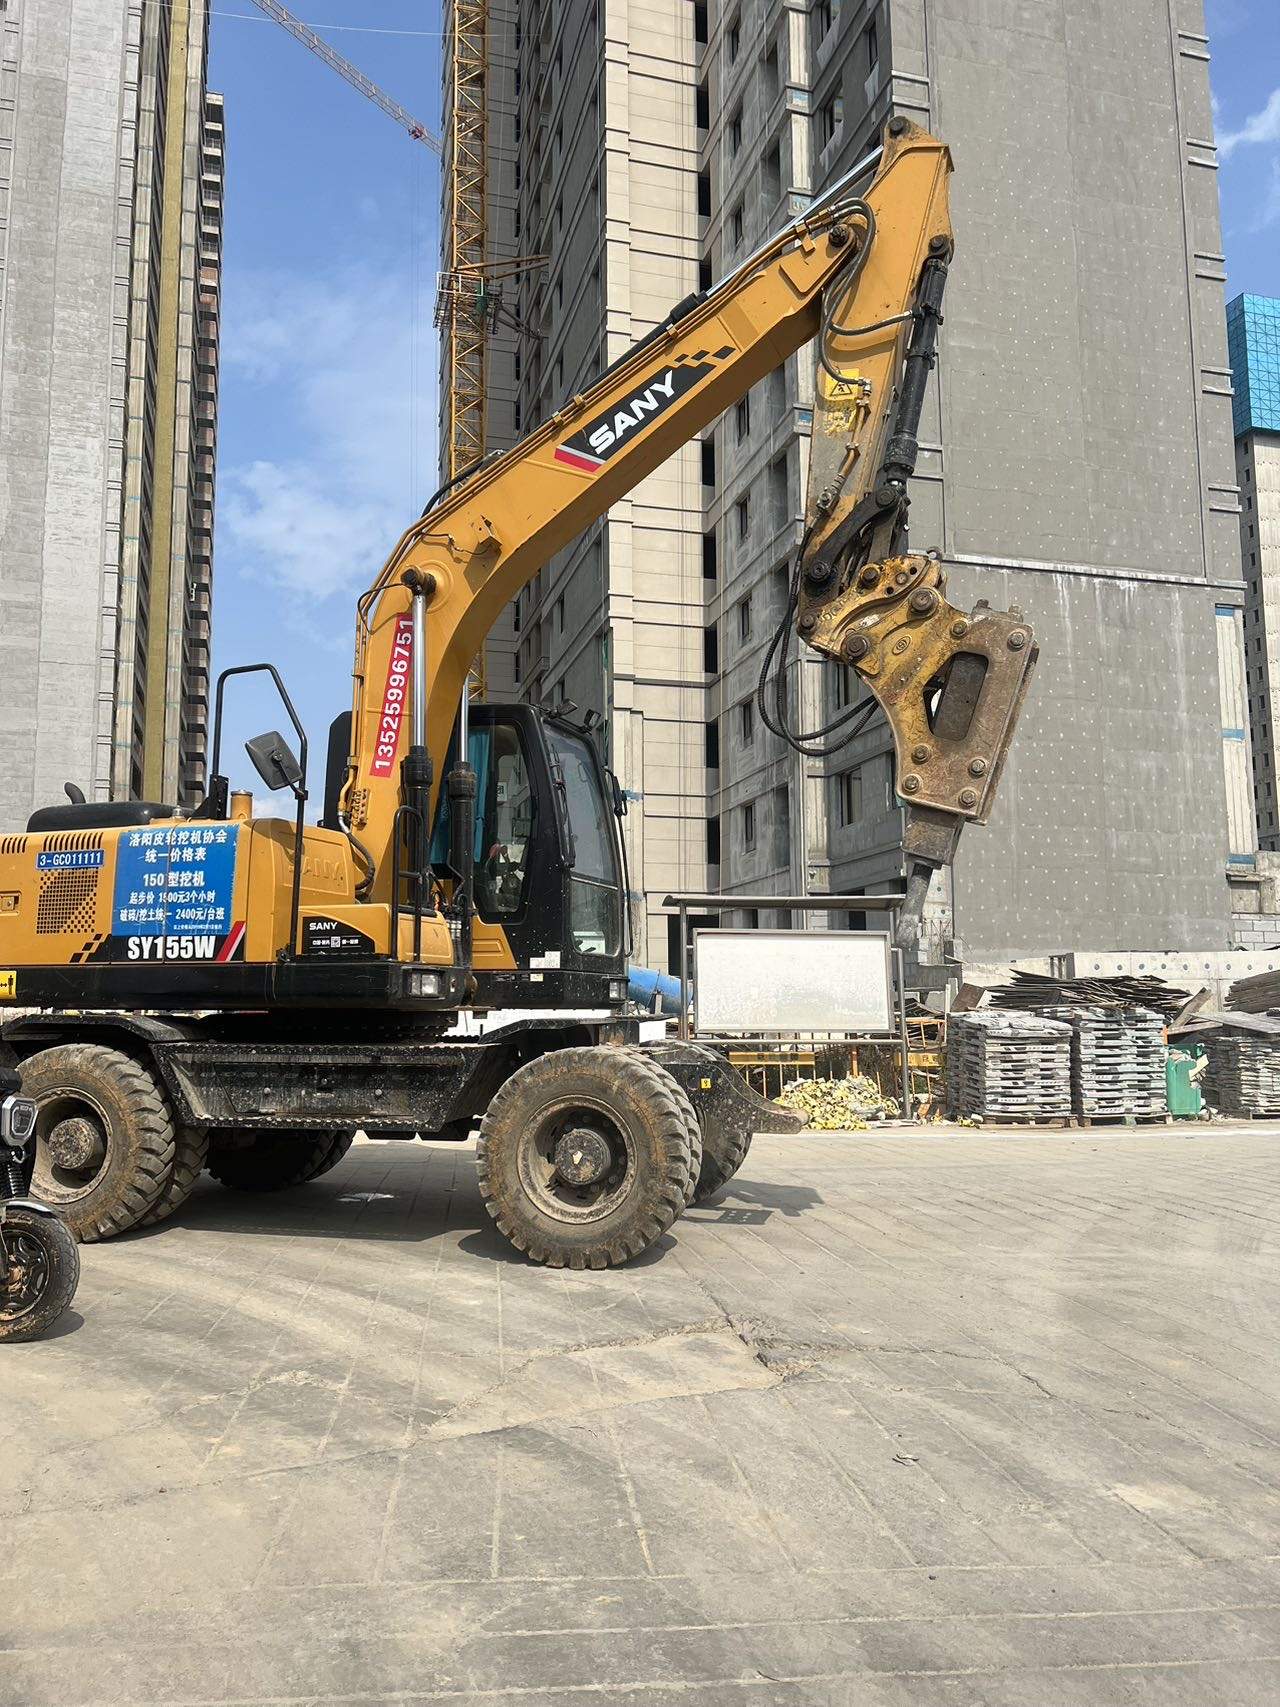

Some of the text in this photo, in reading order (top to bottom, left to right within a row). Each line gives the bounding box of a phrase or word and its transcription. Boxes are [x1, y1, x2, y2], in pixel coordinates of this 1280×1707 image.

[588, 370, 675, 455] SANY
[375, 619, 414, 769] 13525996751
[144, 846, 207, 863] 统一价格表
[143, 870, 205, 887] 150 型挖机
[129, 891, 155, 905] 起步价
[175, 906, 225, 920] 2400元/台班
[309, 921, 338, 931] SANY
[127, 935, 217, 960] SY155W
